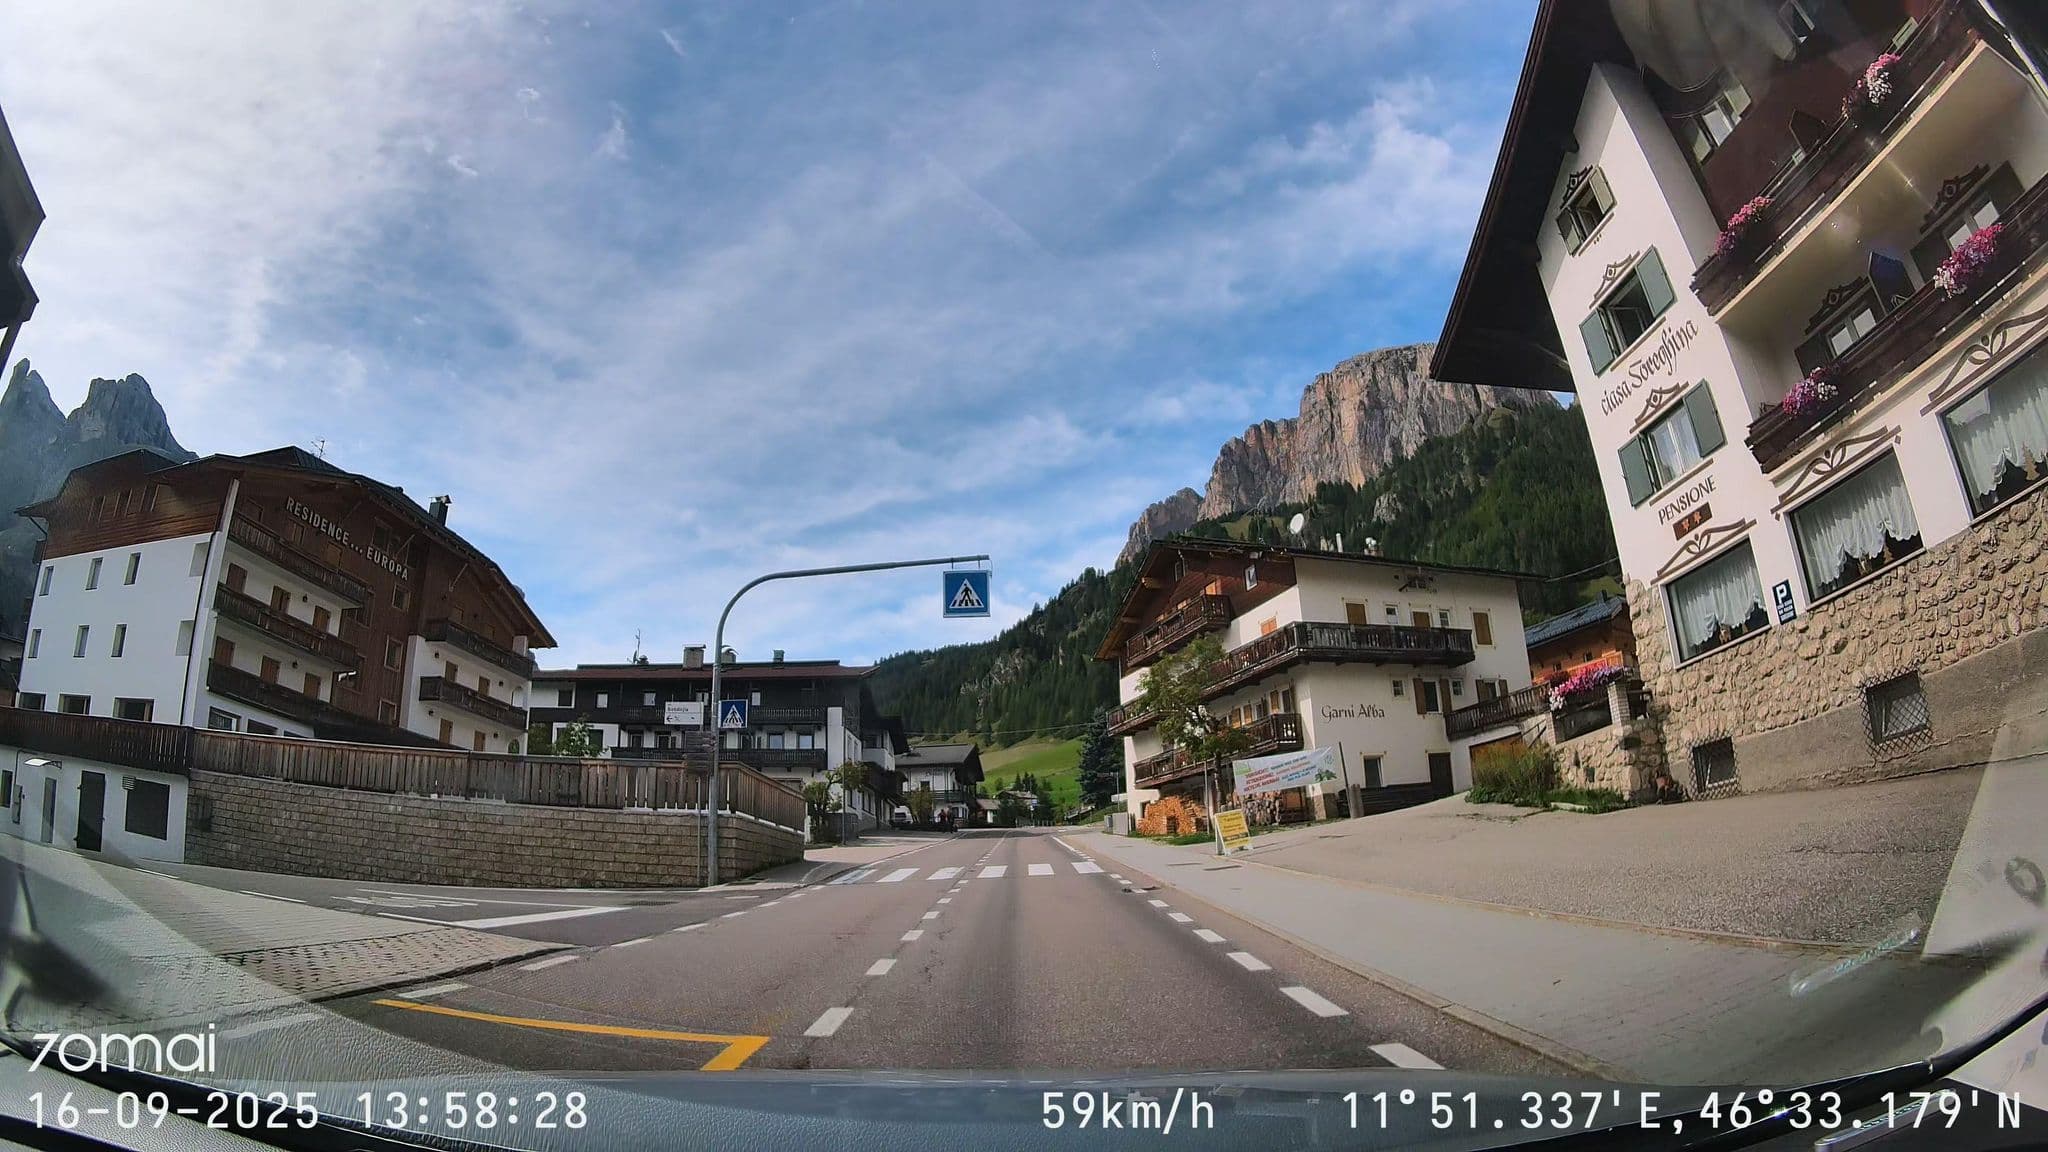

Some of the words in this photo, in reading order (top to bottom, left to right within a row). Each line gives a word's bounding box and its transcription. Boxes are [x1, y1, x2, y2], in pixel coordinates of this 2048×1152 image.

[1601, 380, 1632, 416] ciasa
[1658, 474, 1717, 525] PENSIONE
[366, 546, 408, 581] EUROPA
[1776, 584, 1787, 604] P
[1321, 704, 1355, 723] Garni
[1358, 703, 1385, 718] Alba
